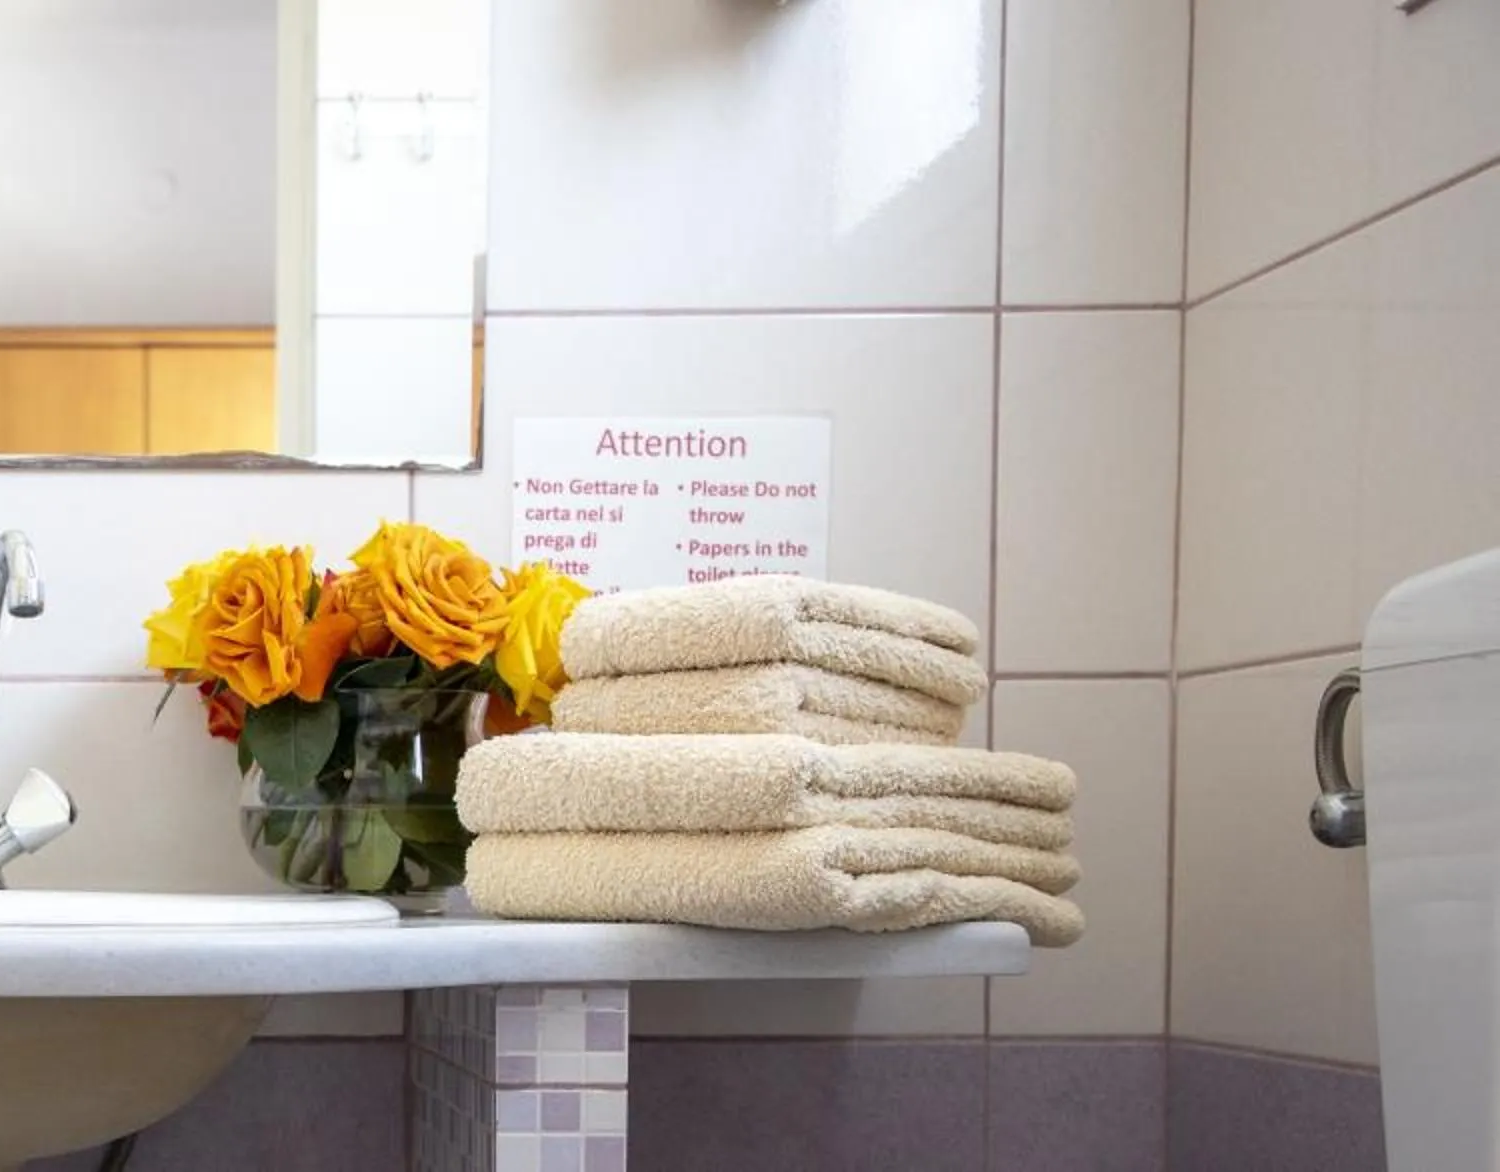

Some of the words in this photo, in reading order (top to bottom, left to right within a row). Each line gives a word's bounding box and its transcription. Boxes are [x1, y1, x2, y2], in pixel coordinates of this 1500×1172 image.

[596, 427, 748, 458] Attention
[526, 478, 564, 494] Non
[569, 479, 638, 495] Gettare
[643, 480, 659, 496] la
[690, 480, 749, 497] Please
[754, 481, 780, 497] Do
[785, 482, 817, 498] not
[525, 506, 571, 521] carta
[576, 505, 604, 522] nel
[608, 506, 623, 522] si
[689, 507, 745, 524] throw
[524, 532, 575, 551] prega
[580, 532, 597, 548] di
[688, 539, 750, 559] Papers
[754, 540, 772, 557] in
[777, 541, 808, 557] the
